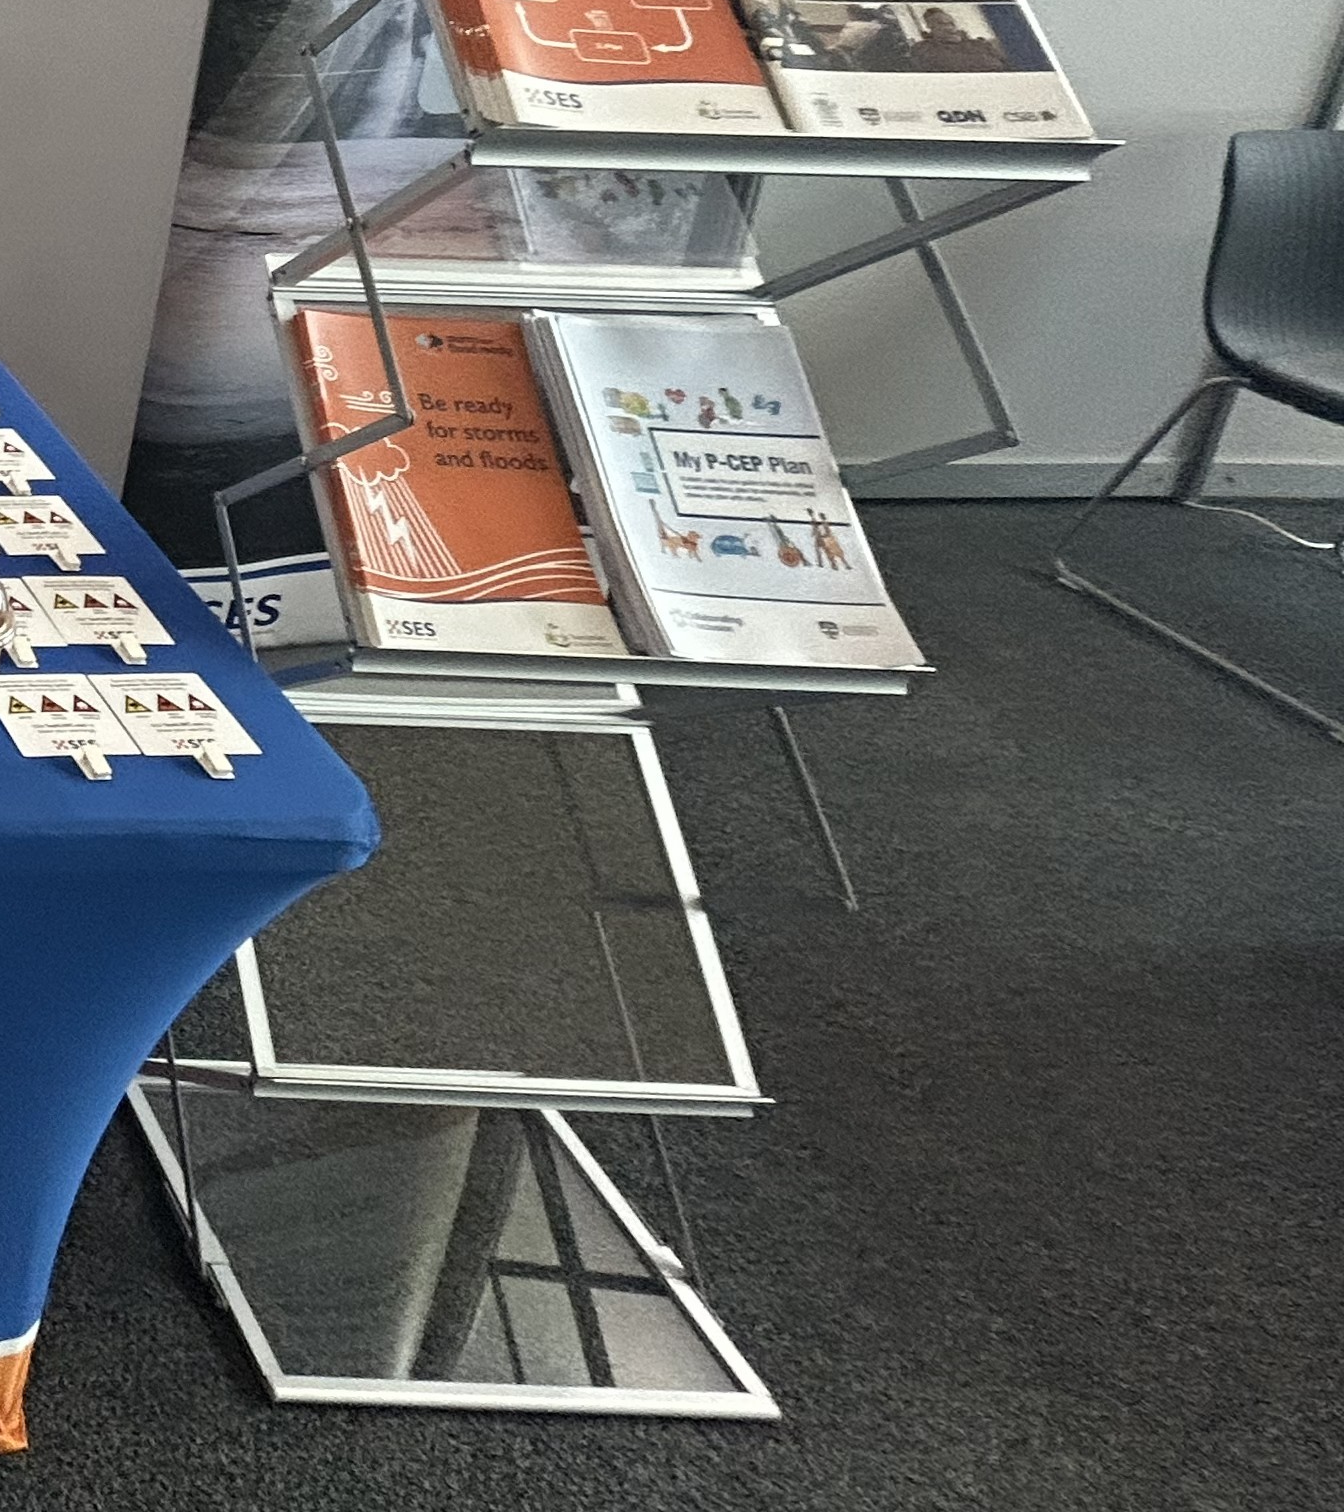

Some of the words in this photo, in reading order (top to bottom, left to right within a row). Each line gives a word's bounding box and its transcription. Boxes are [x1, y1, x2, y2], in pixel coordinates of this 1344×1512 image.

[543, 91, 584, 110] SES
[417, 393, 447, 411] Be
[453, 396, 513, 420] ready
[427, 421, 458, 439] for
[463, 428, 540, 443] storms
[434, 450, 474, 468] and
[479, 450, 549, 470] floods
[673, 451, 702, 472] My
[705, 452, 764, 473] P-CEP
[768, 456, 812, 476] Plan
[402, 620, 436, 638] SES
